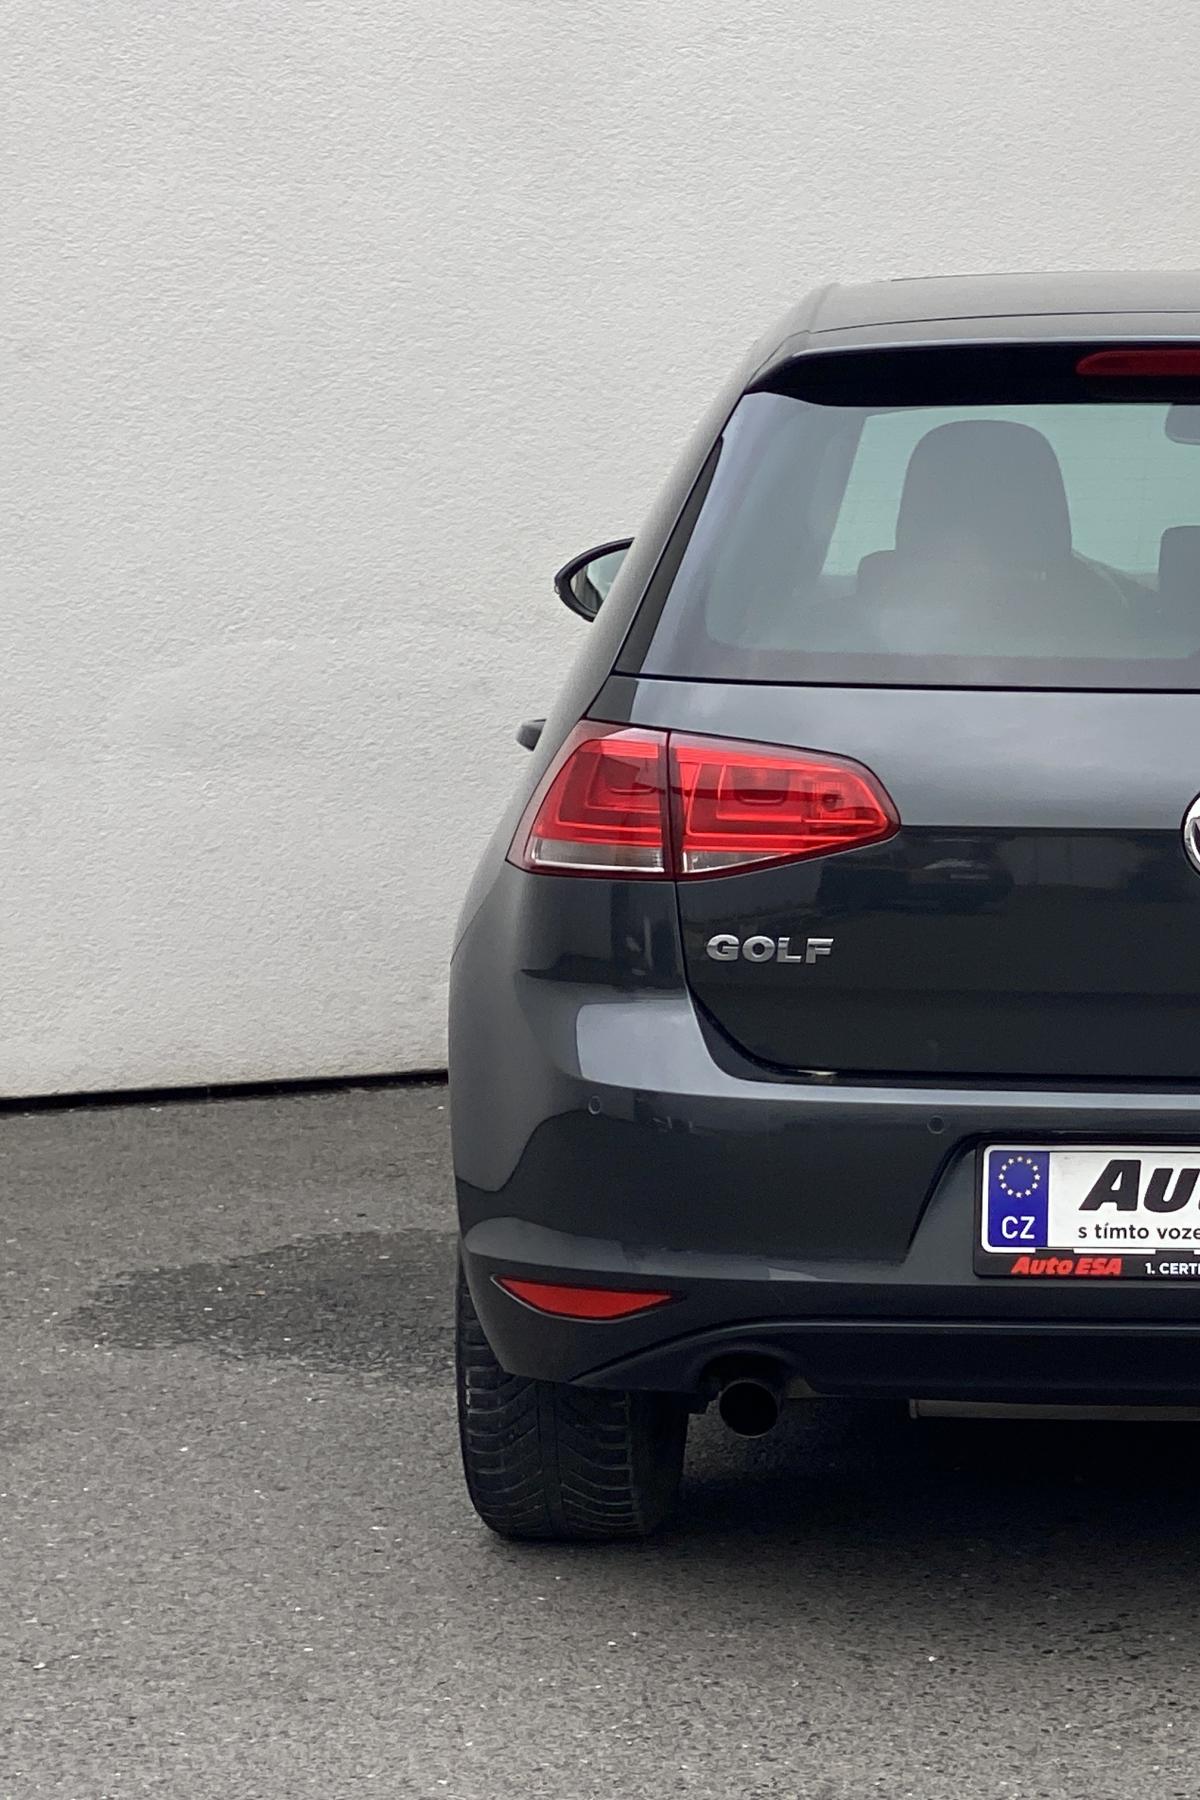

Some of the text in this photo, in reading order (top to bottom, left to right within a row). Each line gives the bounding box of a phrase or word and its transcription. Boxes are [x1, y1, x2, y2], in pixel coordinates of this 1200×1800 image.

[706, 934, 834, 964] GOLF
[1001, 1215, 1035, 1239] CZ
[1077, 1225, 1087, 1239] s
[1094, 1221, 1149, 1240] tímto
[1011, 1256, 1123, 1275] Auto ESA
[1144, 1262, 1156, 1275] 1.
